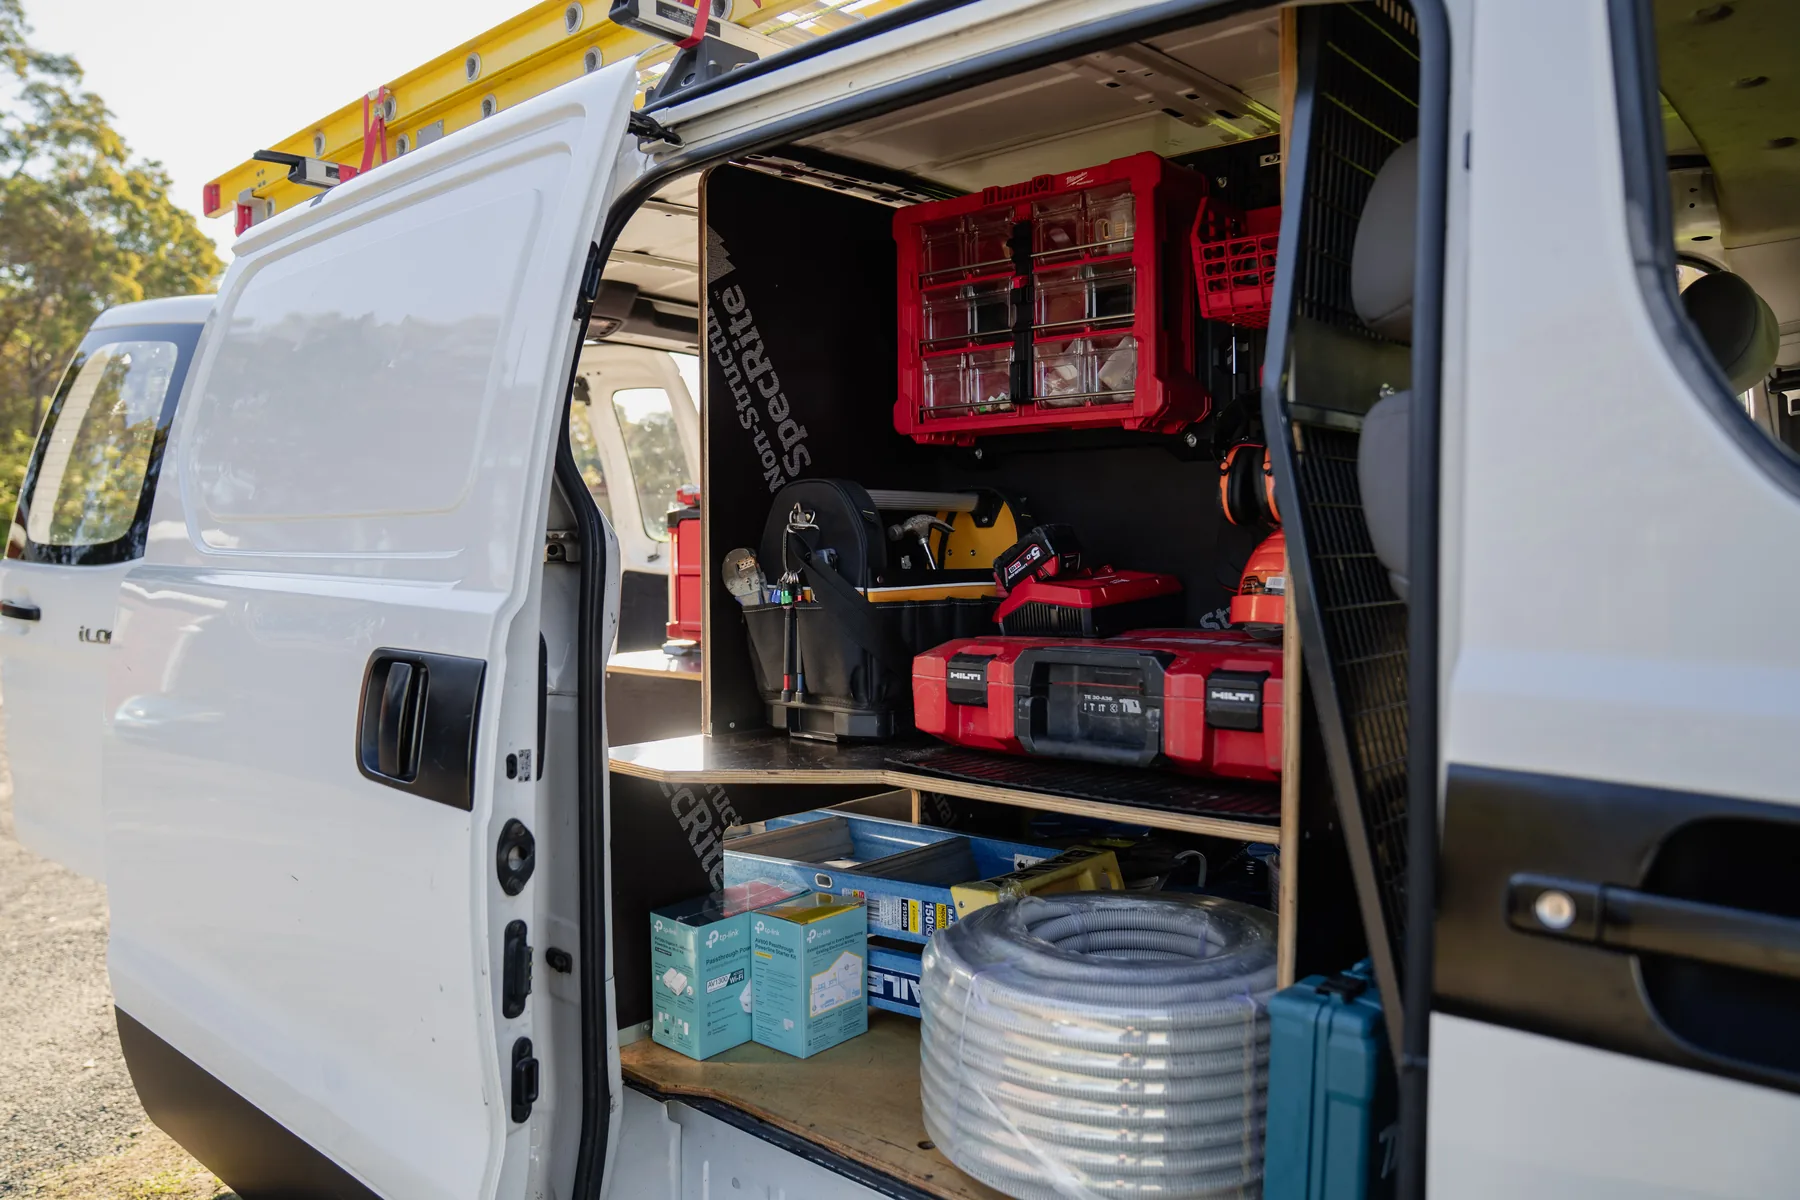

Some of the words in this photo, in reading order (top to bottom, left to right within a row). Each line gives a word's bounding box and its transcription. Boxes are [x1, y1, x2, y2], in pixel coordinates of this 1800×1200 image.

[722, 284, 811, 478] SpecRite
[79, 625, 112, 645] iLo
[951, 671, 981, 681] HILTI
[1211, 690, 1255, 702] HILTI
[755, 944, 775, 954] Powerline
[775, 949, 790, 958] Starter
[768, 941, 795, 954] Passthrough
[706, 949, 739, 966] Passthrough
[730, 974, 744, 984] Wi-Fi
